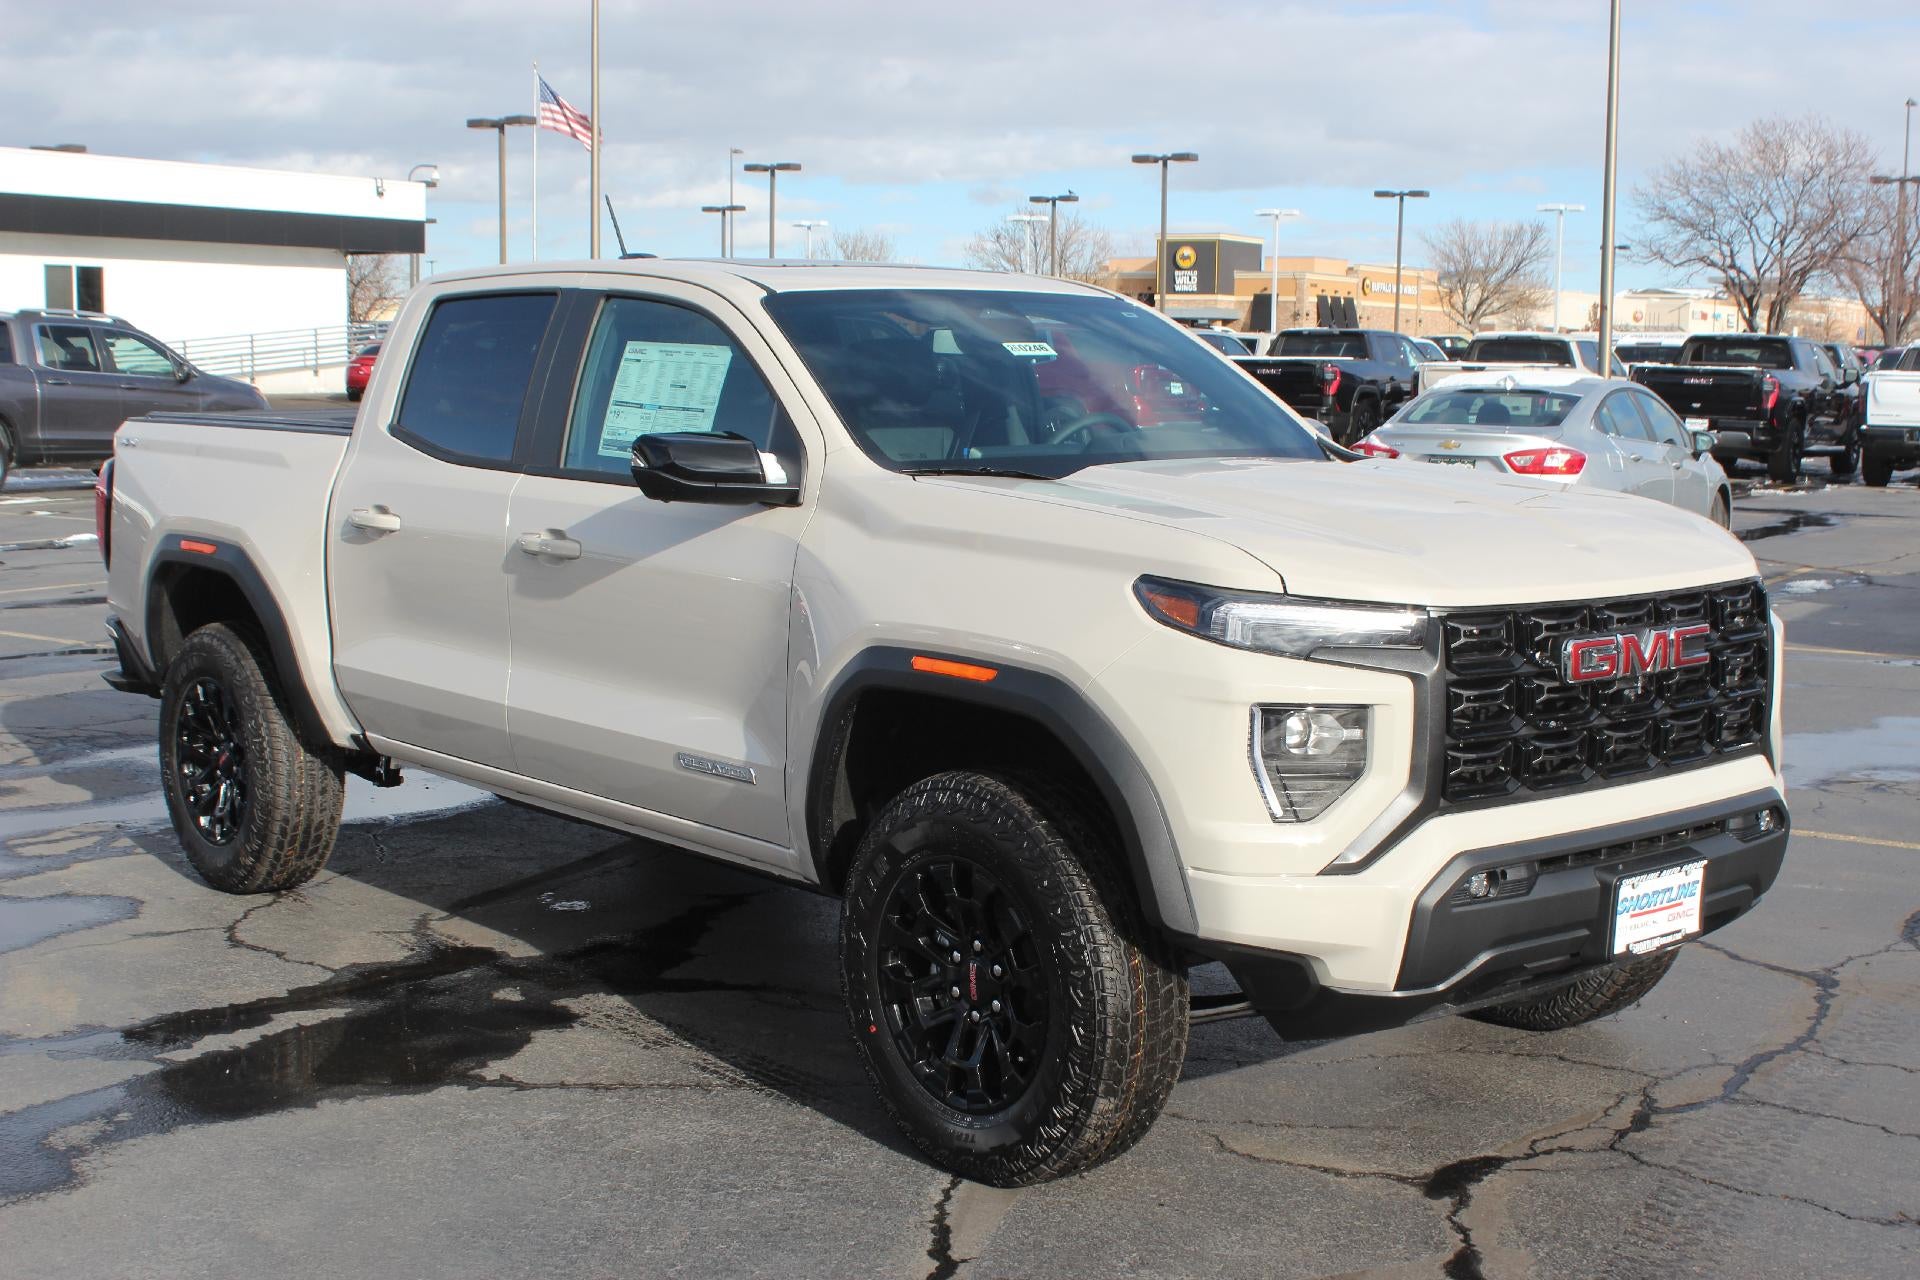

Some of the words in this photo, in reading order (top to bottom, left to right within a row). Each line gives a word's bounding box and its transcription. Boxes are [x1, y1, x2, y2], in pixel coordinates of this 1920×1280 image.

[1175, 275, 1197, 284] WILD
[1567, 623, 1710, 683] GMC
[1617, 880, 1700, 915] SHORTLINE
[1667, 908, 1695, 922] GMC
